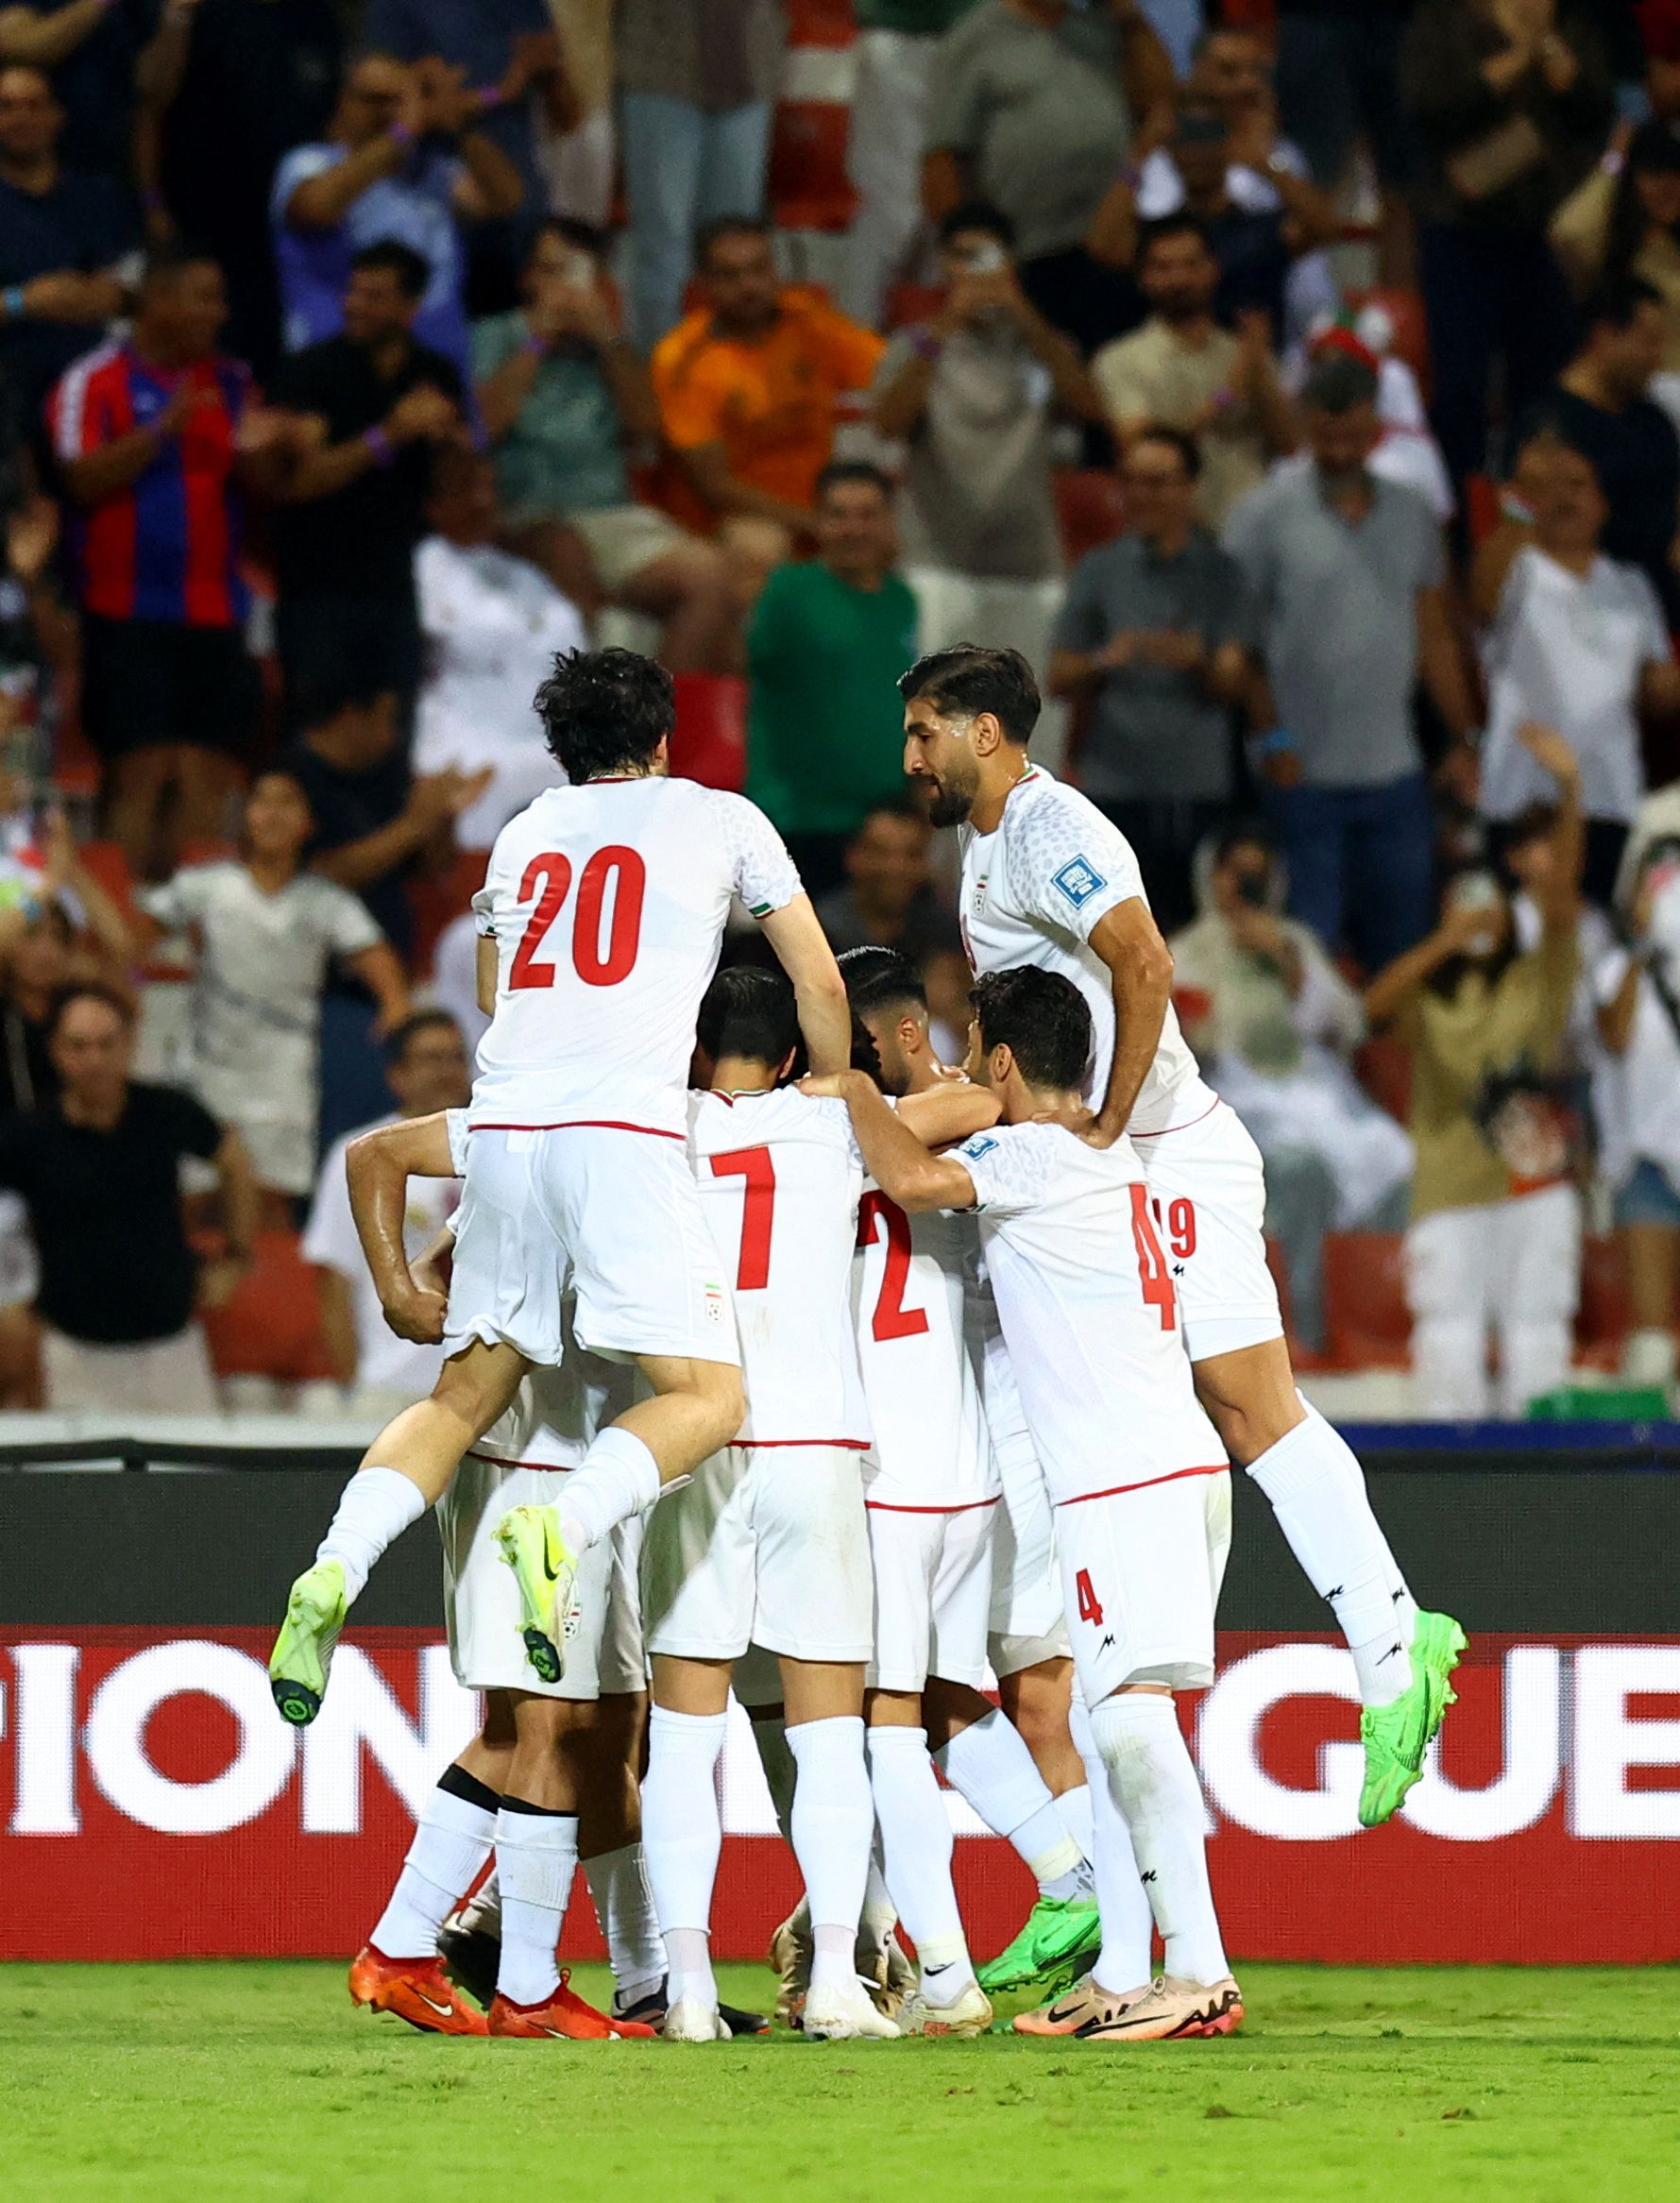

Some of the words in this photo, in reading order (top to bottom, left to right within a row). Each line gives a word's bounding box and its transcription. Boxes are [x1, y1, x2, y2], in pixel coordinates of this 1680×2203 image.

[511, 845, 646, 990] 20
[710, 1145, 775, 1290] 7
[857, 1190, 929, 1342] 2
[1128, 1183, 1177, 1330] 4
[1076, 1568, 1104, 1627] 4
[0, 1639, 486, 1838] ION
